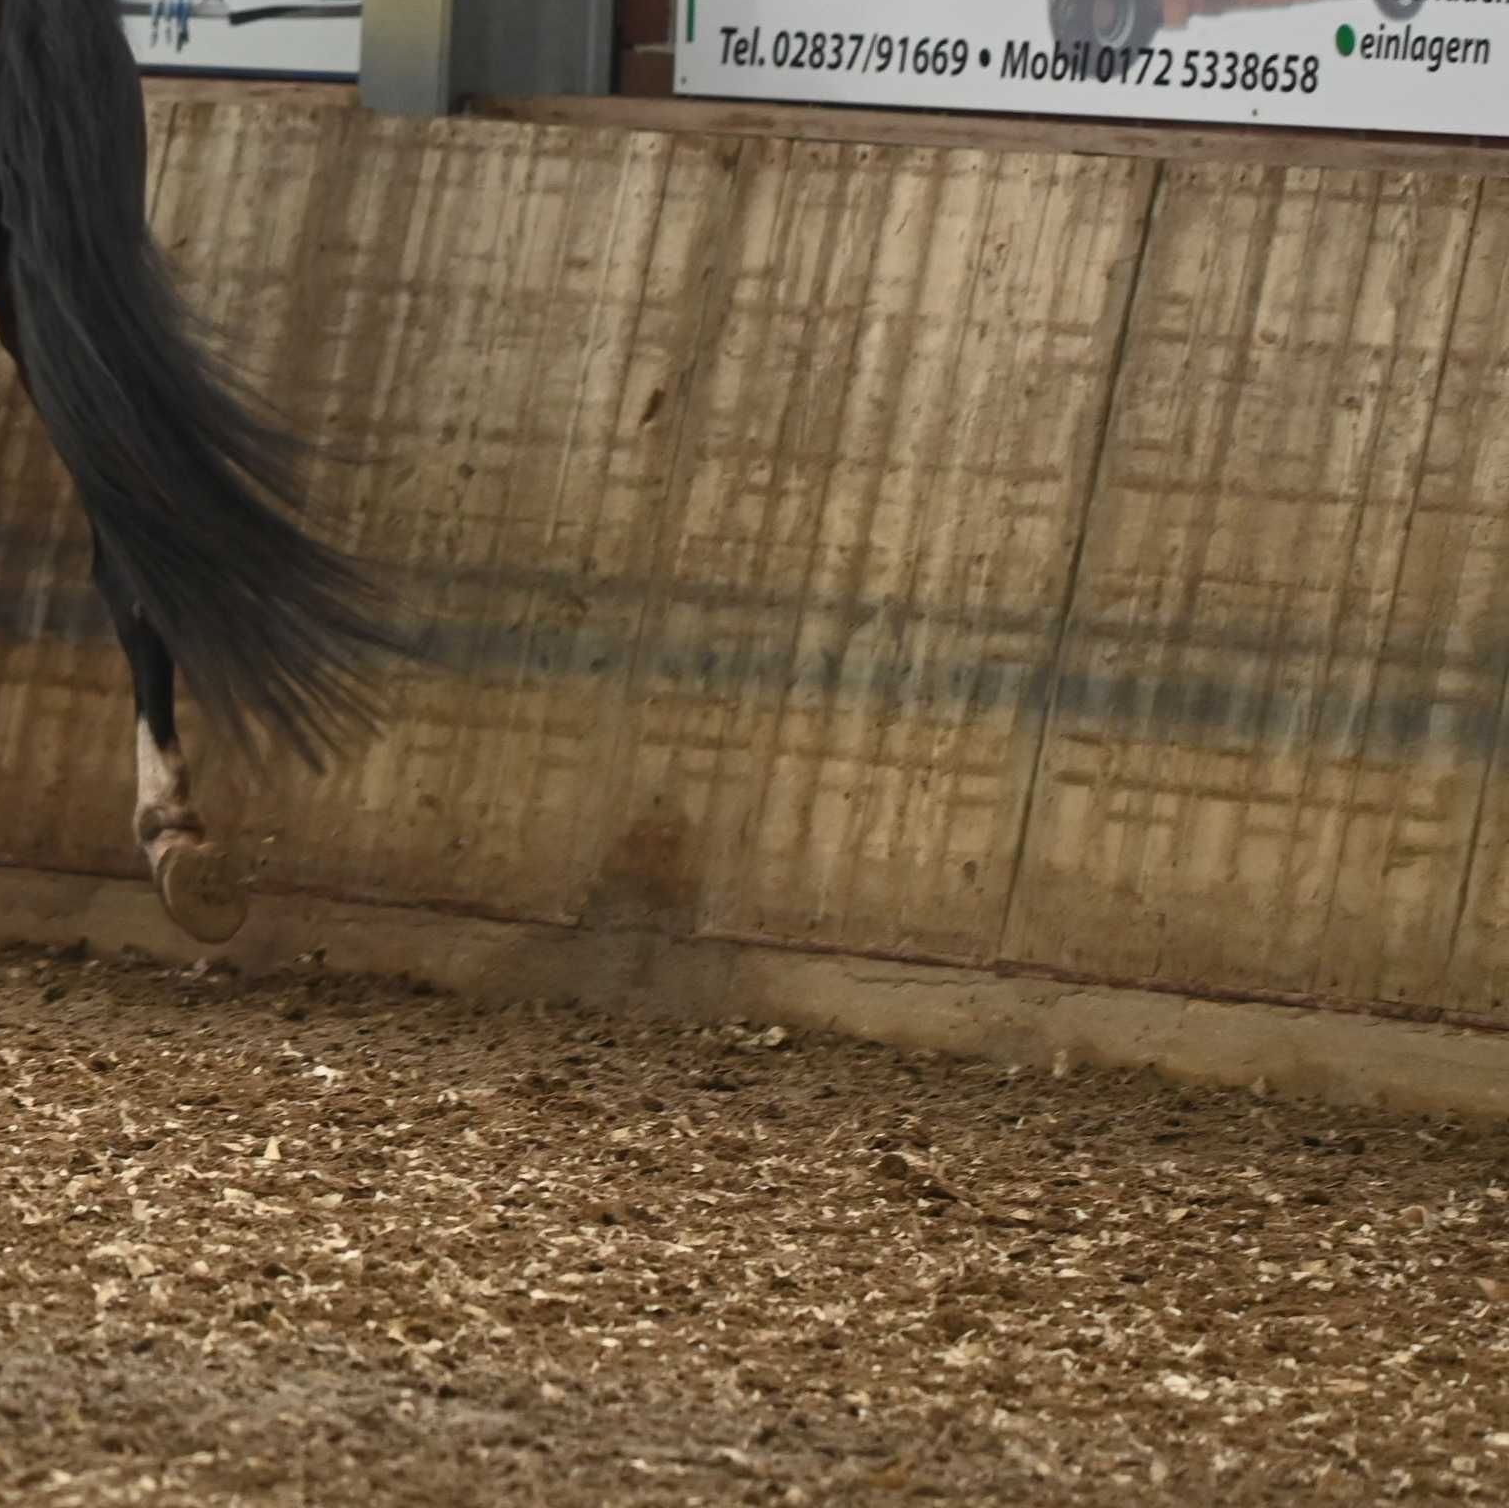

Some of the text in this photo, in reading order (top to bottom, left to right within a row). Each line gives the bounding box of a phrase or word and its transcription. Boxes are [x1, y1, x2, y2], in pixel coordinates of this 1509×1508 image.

[720, 27, 1321, 95] Tel. 02837/91669 Mobil 0172 5338658
[1360, 23, 1491, 73] einlagern
